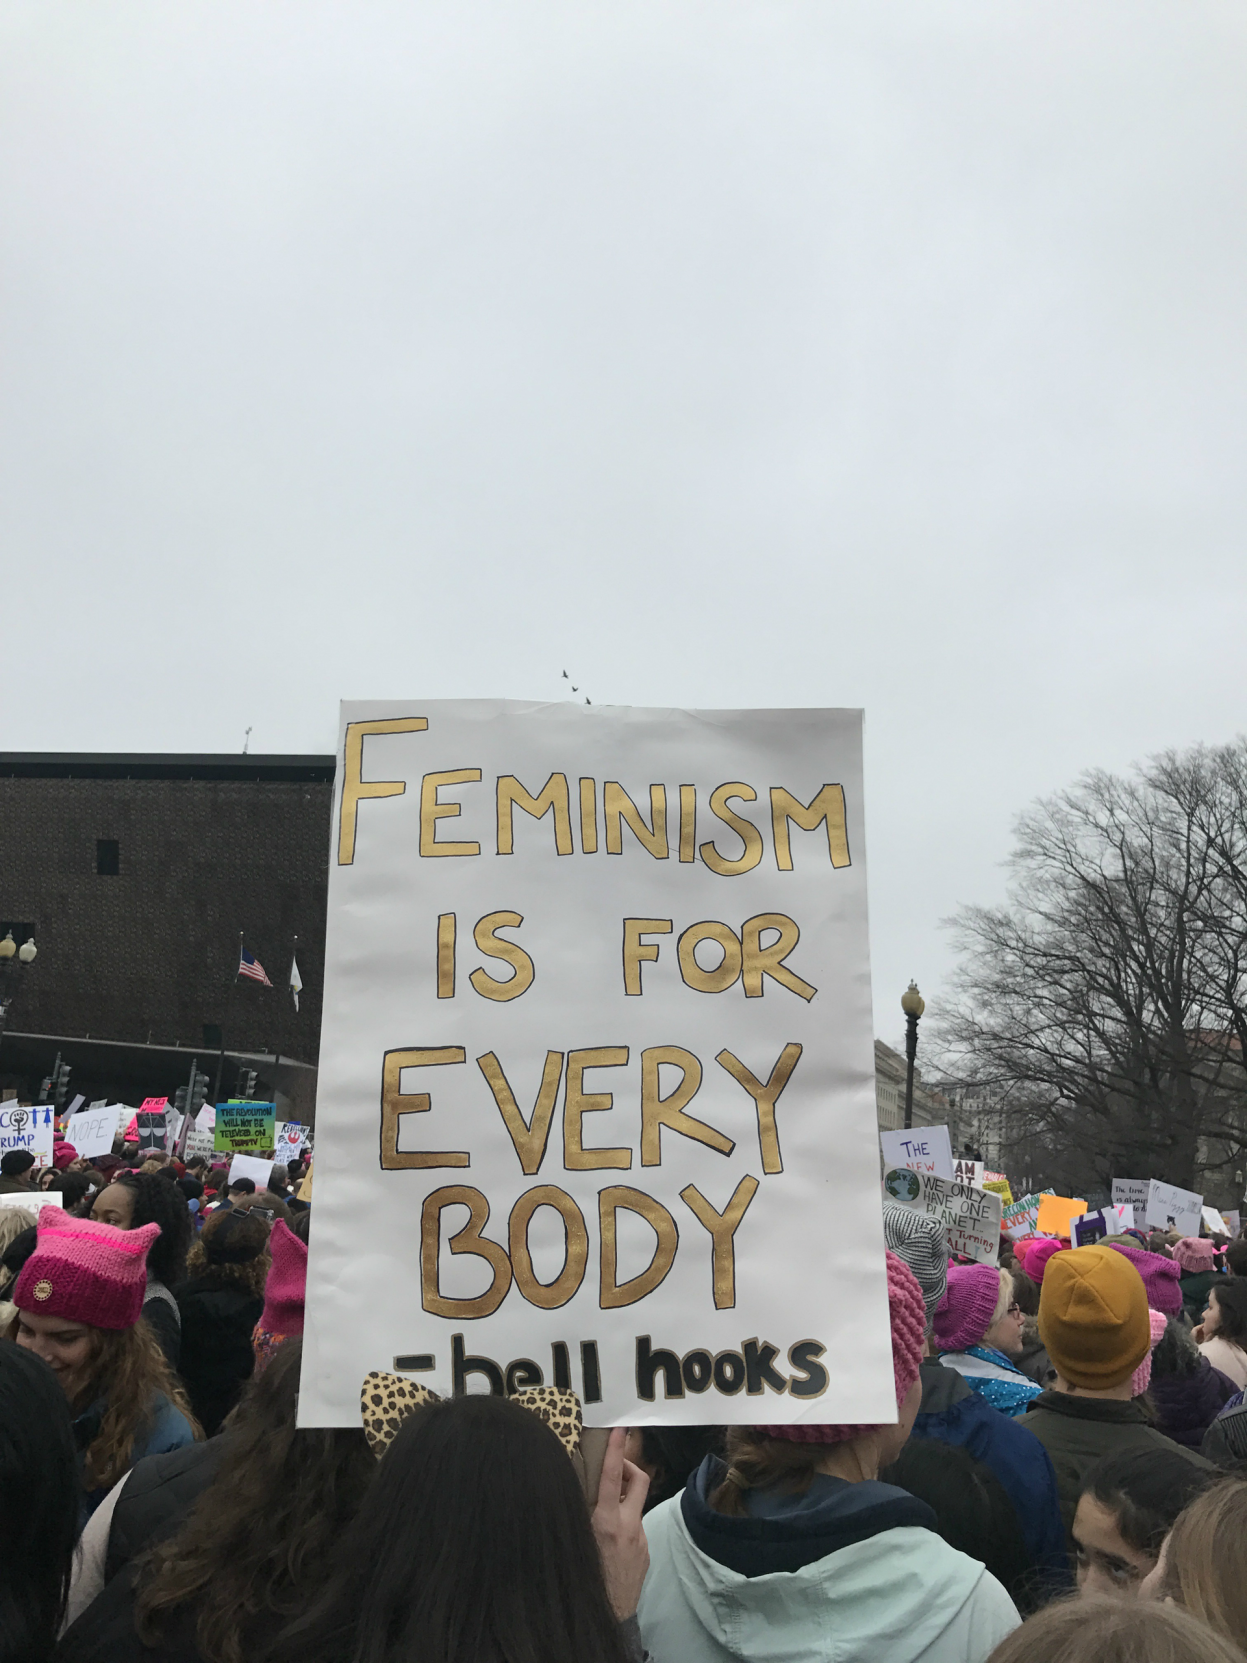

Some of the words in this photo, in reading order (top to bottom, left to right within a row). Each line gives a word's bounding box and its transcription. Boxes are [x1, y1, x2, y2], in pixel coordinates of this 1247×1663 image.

[338, 717, 852, 877] FEMINISM
[437, 910, 536, 1003] IS
[623, 912, 818, 1003] FOR
[221, 1108, 235, 1116] THE
[236, 1107, 272, 1117] REVOLUTION
[380, 1042, 803, 1176] EVERY
[68, 1117, 109, 1142] NOPE
[223, 1118, 239, 1127] WILL
[241, 1118, 252, 1127] NOT
[254, 1119, 264, 1127] BE
[899, 1140, 931, 1159] THE
[954, 1160, 976, 1177] AM
[921, 1174, 946, 1193] WE
[950, 1183, 988, 1205] ONLY
[1115, 1185, 1126, 1193] The
[923, 1189, 954, 1210] HAVE
[960, 1201, 991, 1219] ONE
[1003, 1208, 1033, 1231] EVERY
[420, 1173, 760, 1320] BODY
[955, 1229, 995, 1254] Turning
[635, 1335, 831, 1403] hooks
